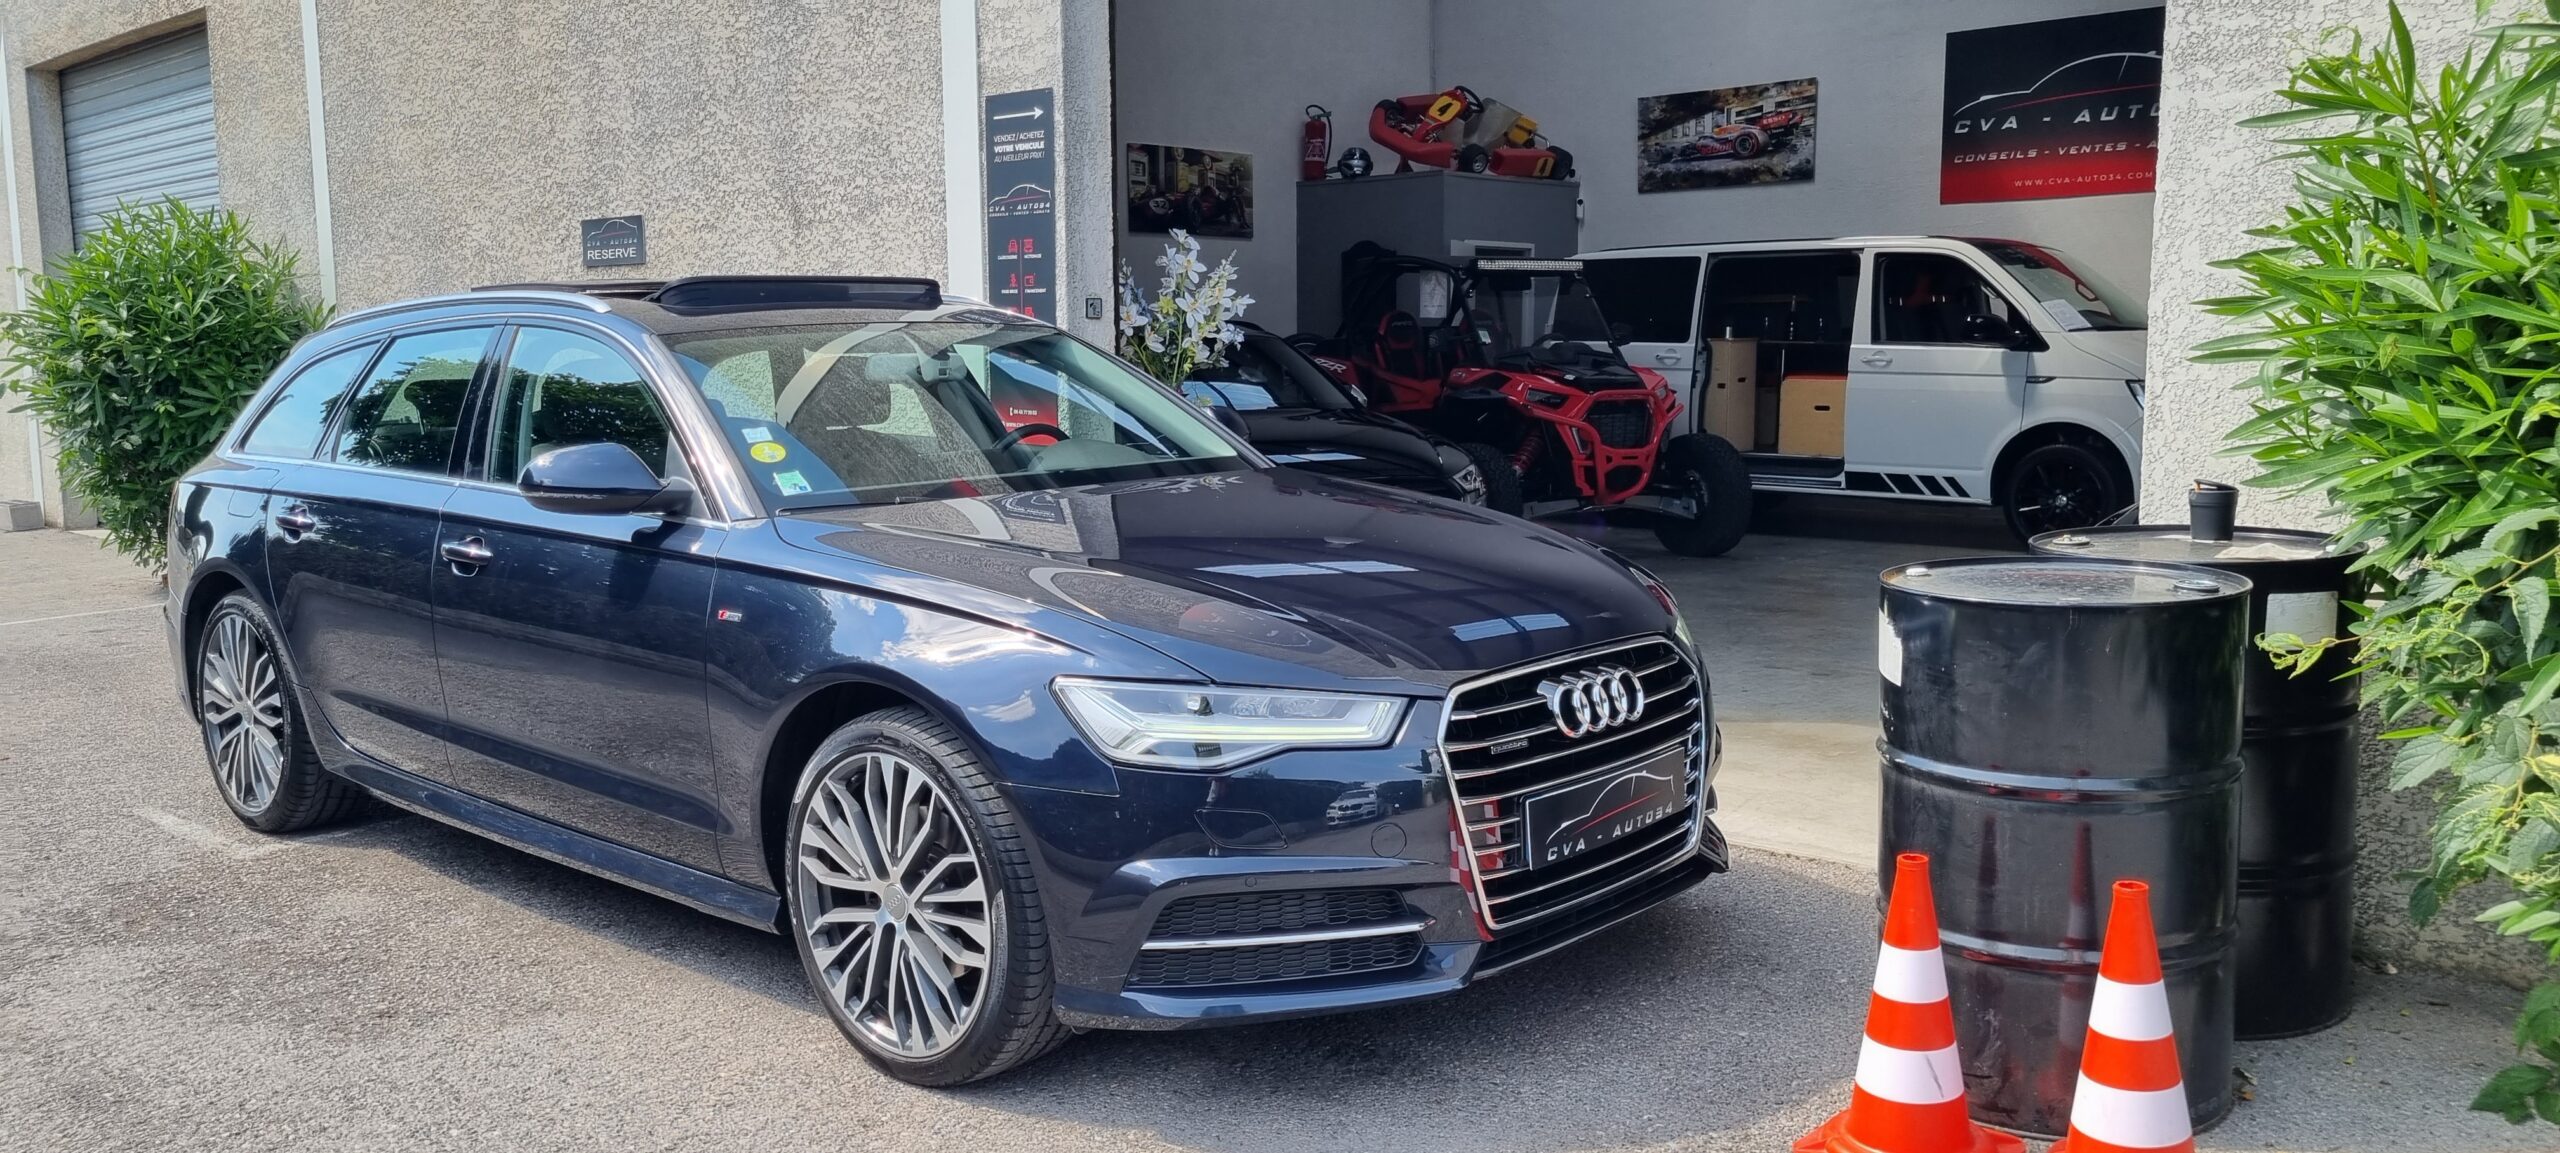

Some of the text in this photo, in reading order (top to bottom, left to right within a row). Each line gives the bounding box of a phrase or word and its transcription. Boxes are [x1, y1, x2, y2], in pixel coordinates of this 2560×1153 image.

[1954, 115, 2018, 134] CVA
[993, 144, 1014, 154] VOTRE
[1954, 149, 2038, 163] CONSEILS
[2058, 141, 2128, 155] VENTES
[2014, 171, 2153, 187] WWW.CVA-AUTO34.COM
[587, 247, 637, 260] RESERVE
[1547, 838, 1586, 861] CVA
[1612, 801, 1673, 838] AUTO34
